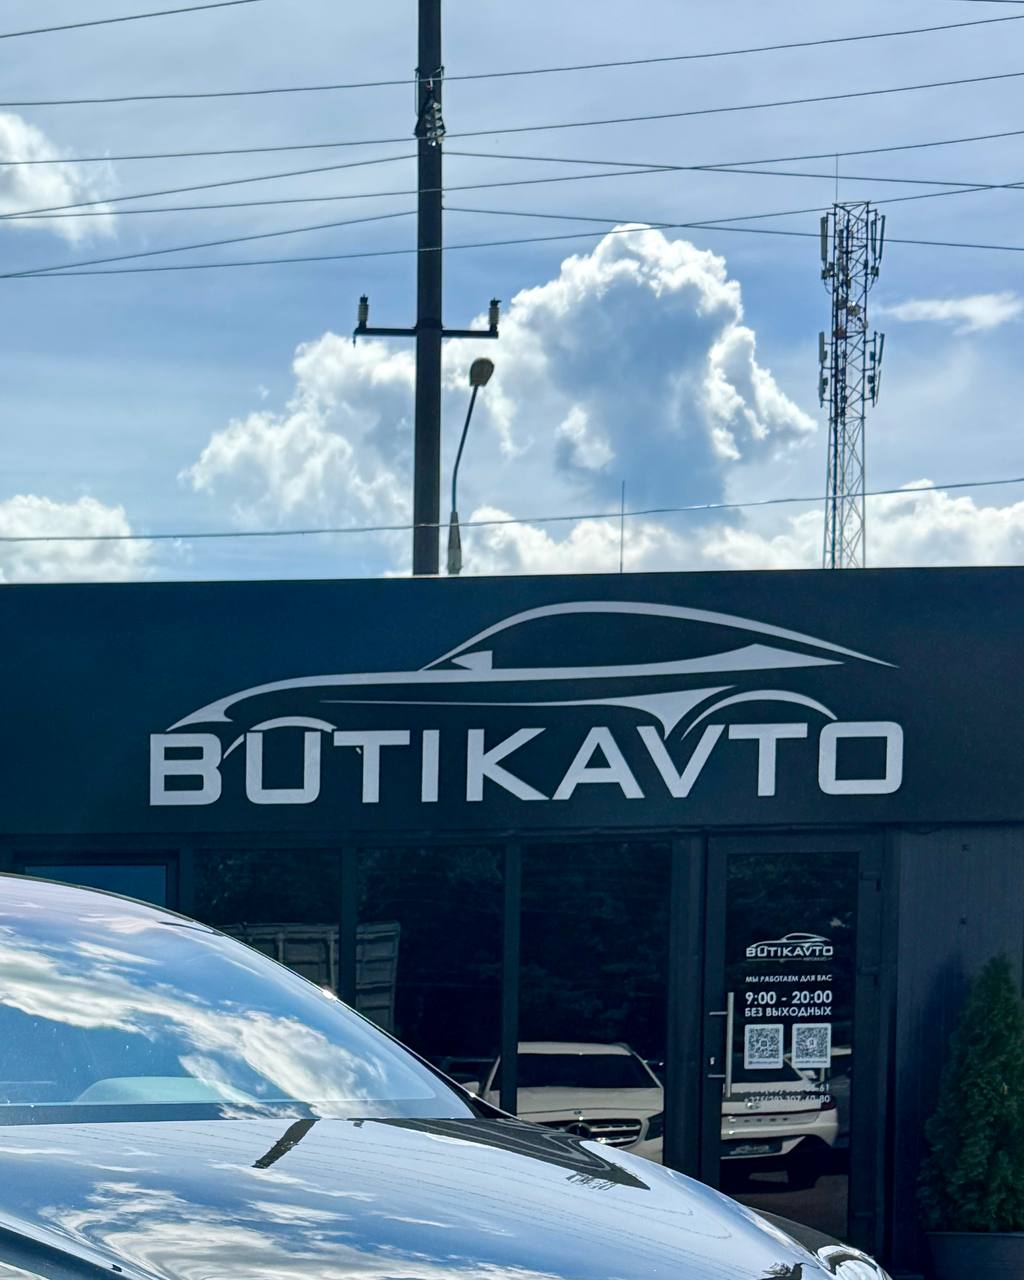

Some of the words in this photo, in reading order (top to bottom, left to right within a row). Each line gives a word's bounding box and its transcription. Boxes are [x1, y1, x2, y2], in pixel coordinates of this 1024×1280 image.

[150, 721, 904, 806] BUTIKAVTO
[746, 946, 833, 958] BUTIKAVTO
[760, 975, 799, 983] РАБОТАЕМ
[817, 974, 833, 982] ВАС
[745, 992, 776, 1005] 9:00
[792, 991, 832, 1003] 20:00
[745, 1008, 763, 1017] БЕЗ
[766, 1006, 832, 1017] ВЫХОДНЫХ
